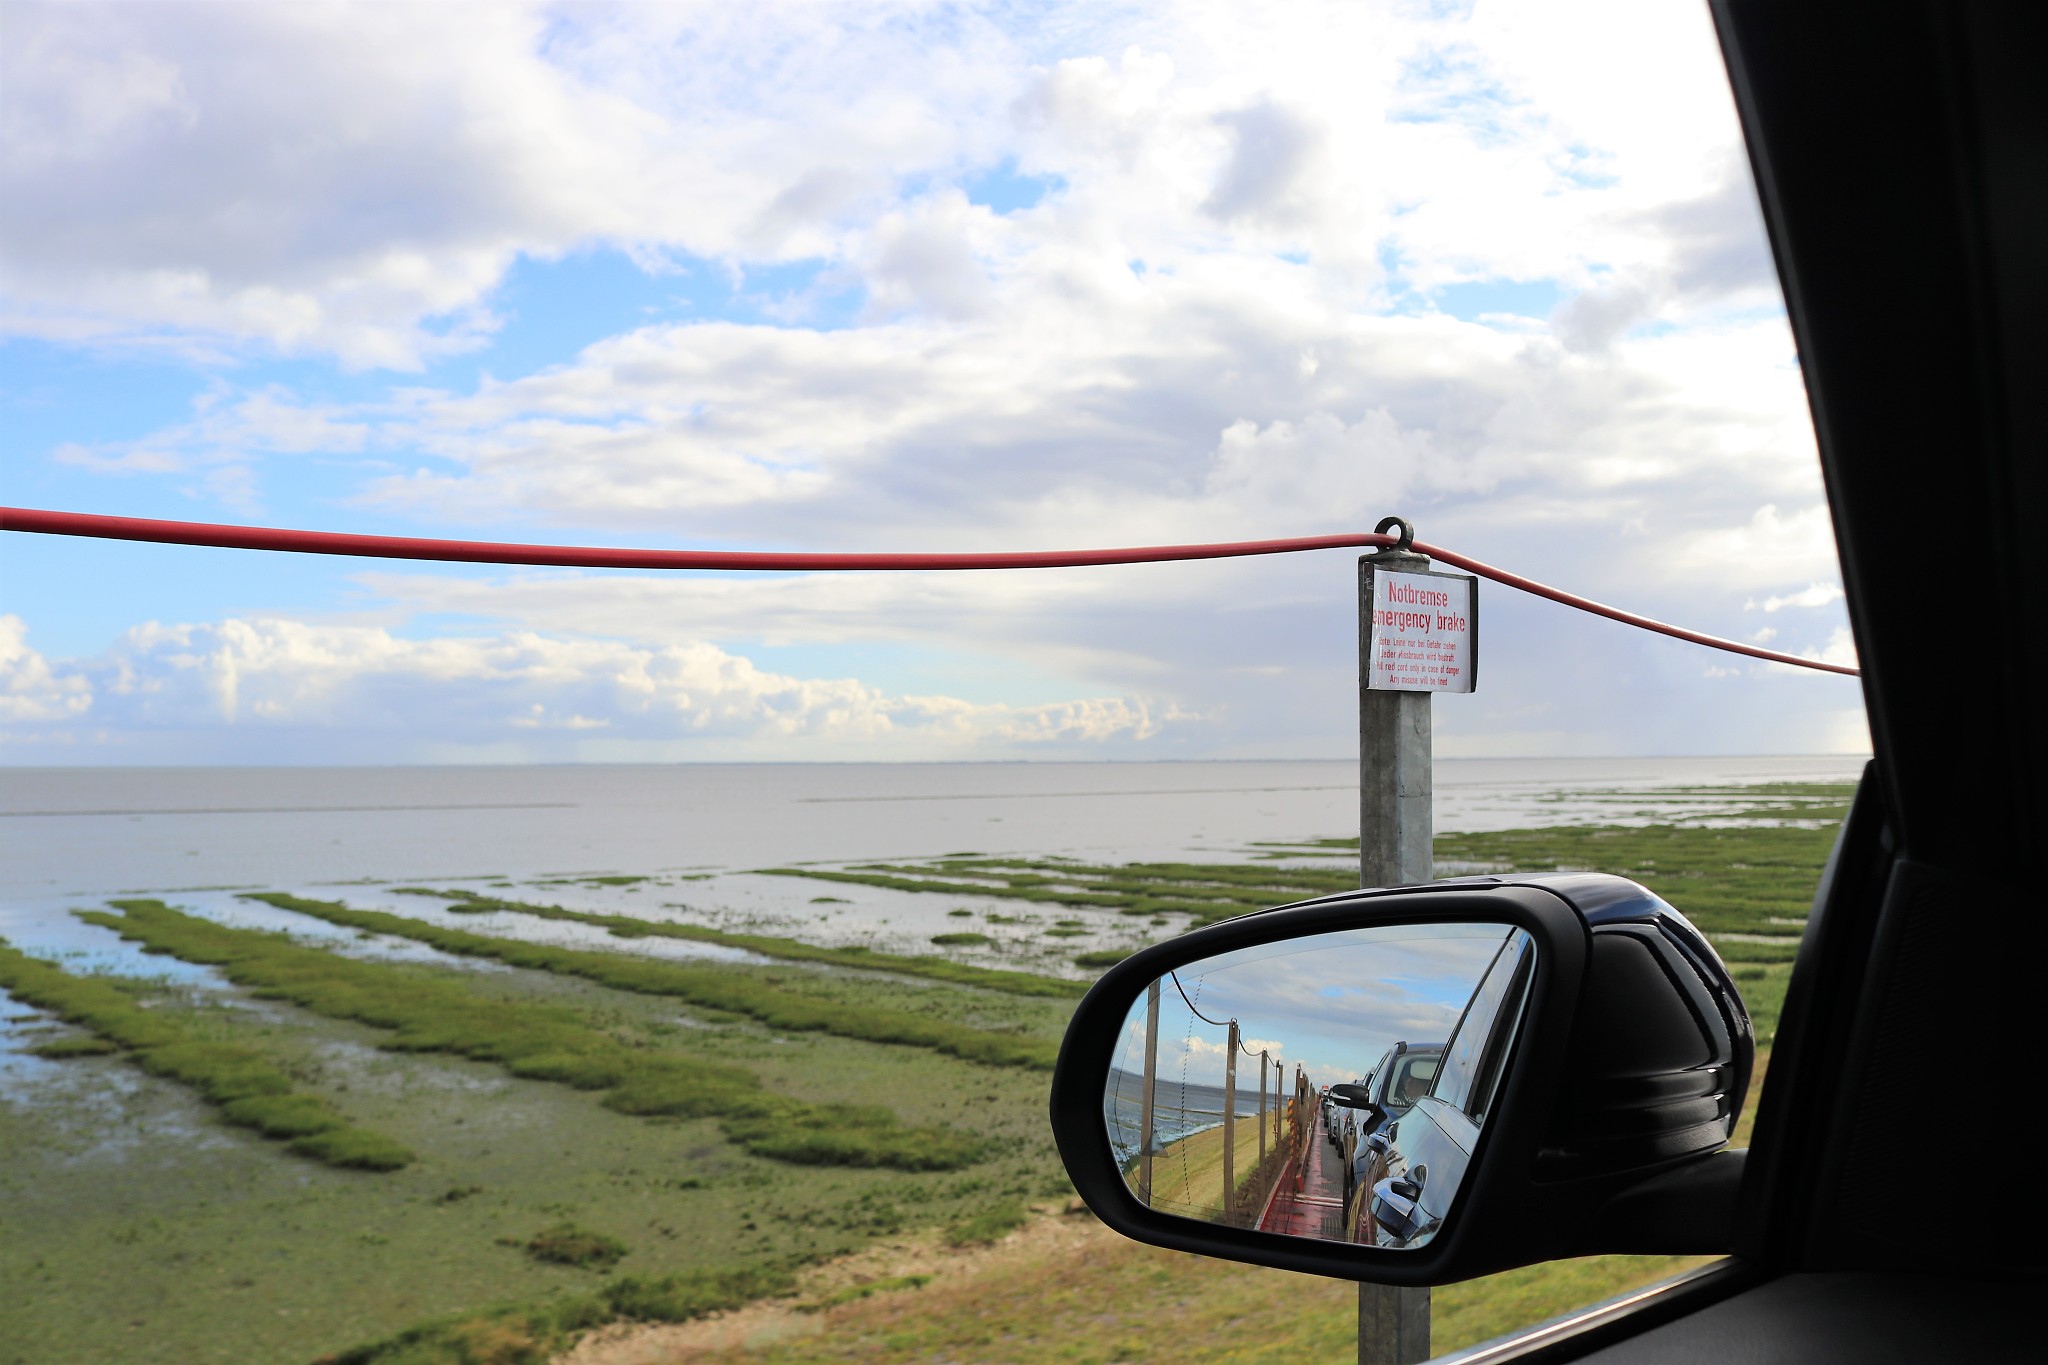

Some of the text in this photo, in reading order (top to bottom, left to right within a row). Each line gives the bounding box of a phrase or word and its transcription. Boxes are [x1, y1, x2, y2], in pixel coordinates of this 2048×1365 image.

[1389, 581, 1448, 607] Notbremse
[1372, 609, 1465, 634] emergency brake
[1393, 637, 1406, 647] Leine
[1385, 662, 1396, 671] red
[1389, 674, 1399, 685] Any
